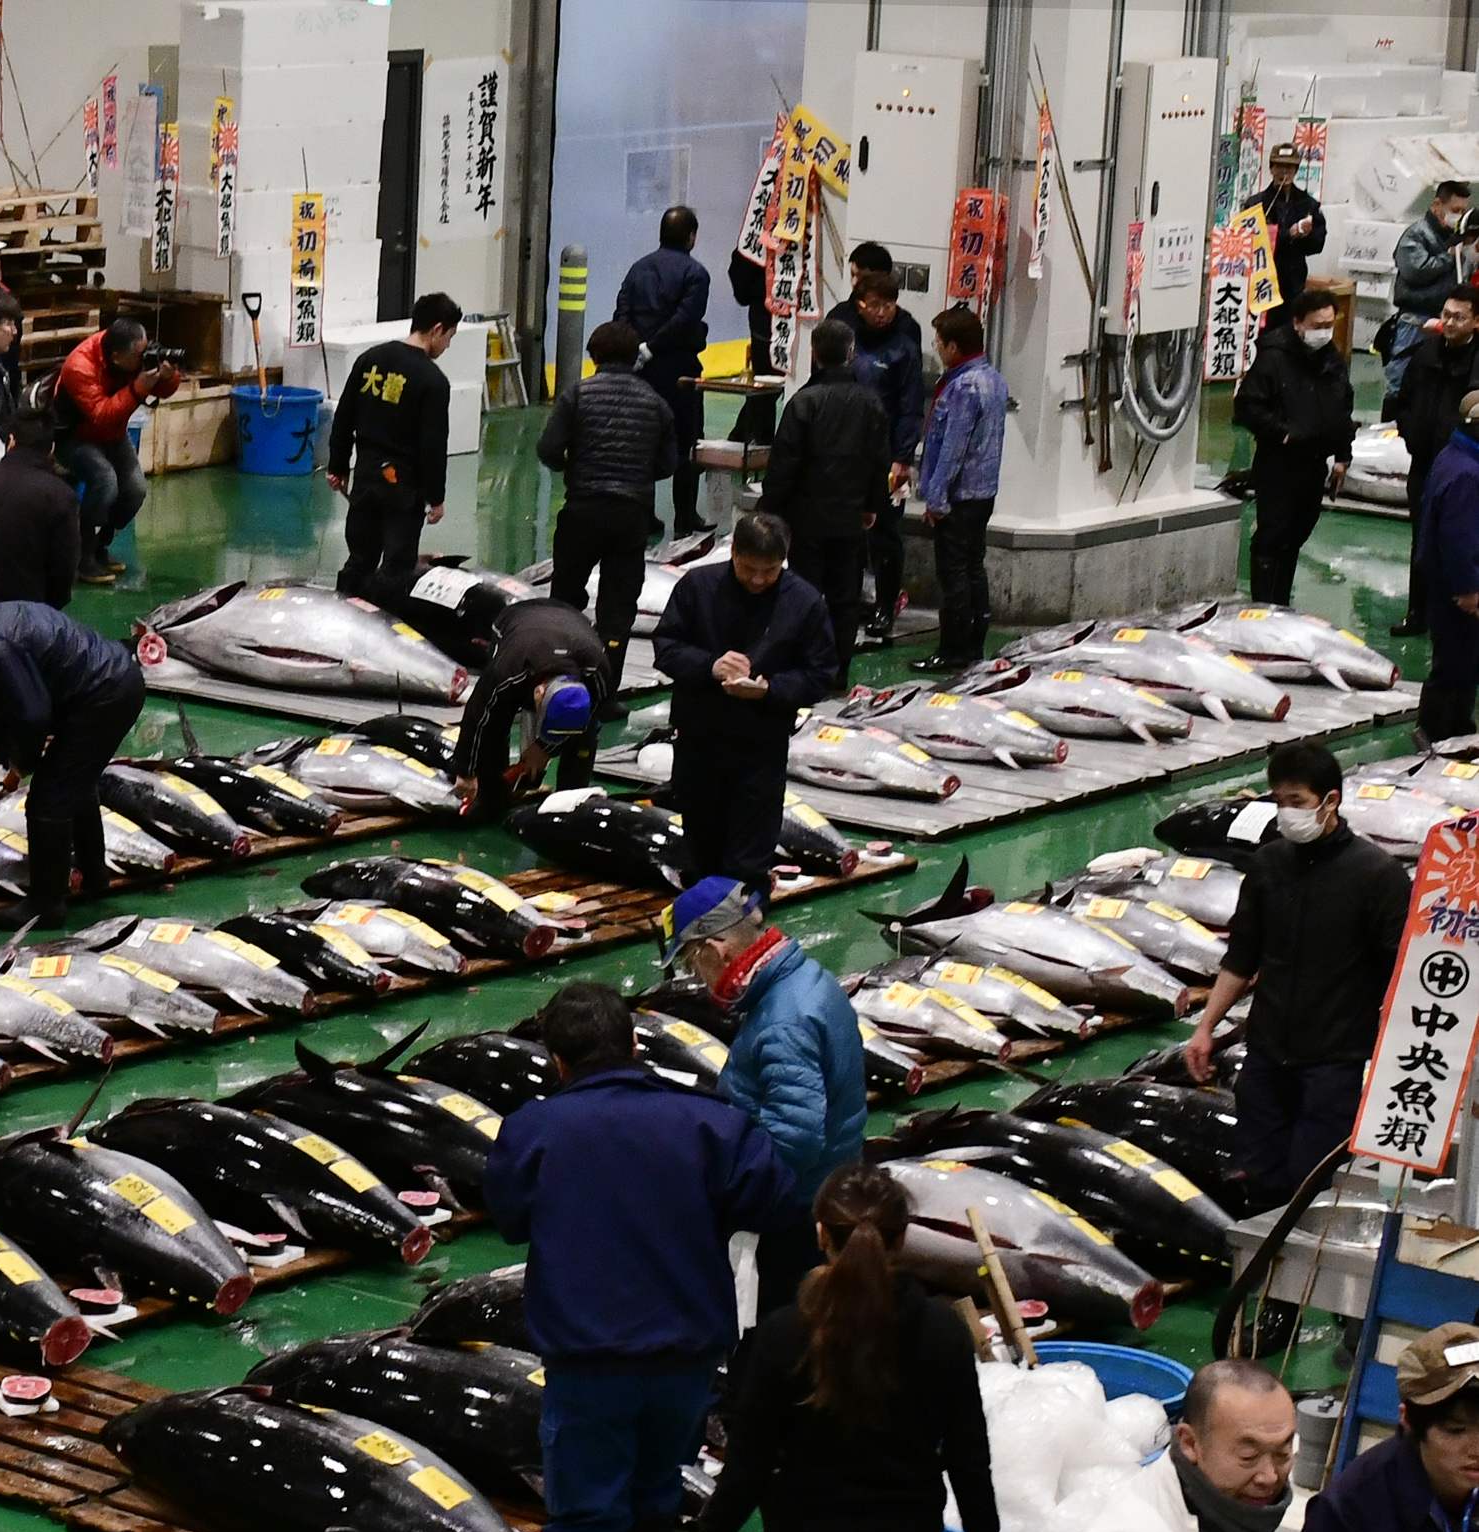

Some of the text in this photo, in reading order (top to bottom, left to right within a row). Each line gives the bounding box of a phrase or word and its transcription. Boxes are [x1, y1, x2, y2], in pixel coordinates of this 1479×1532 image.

[475, 70, 498, 222] 謹賀新年
[296, 201, 317, 282] 祝初荷
[959, 198, 984, 293] 祝初荷
[1211, 282, 1243, 376] 大都魚類
[1375, 1003, 1460, 1157] 中央魚類
